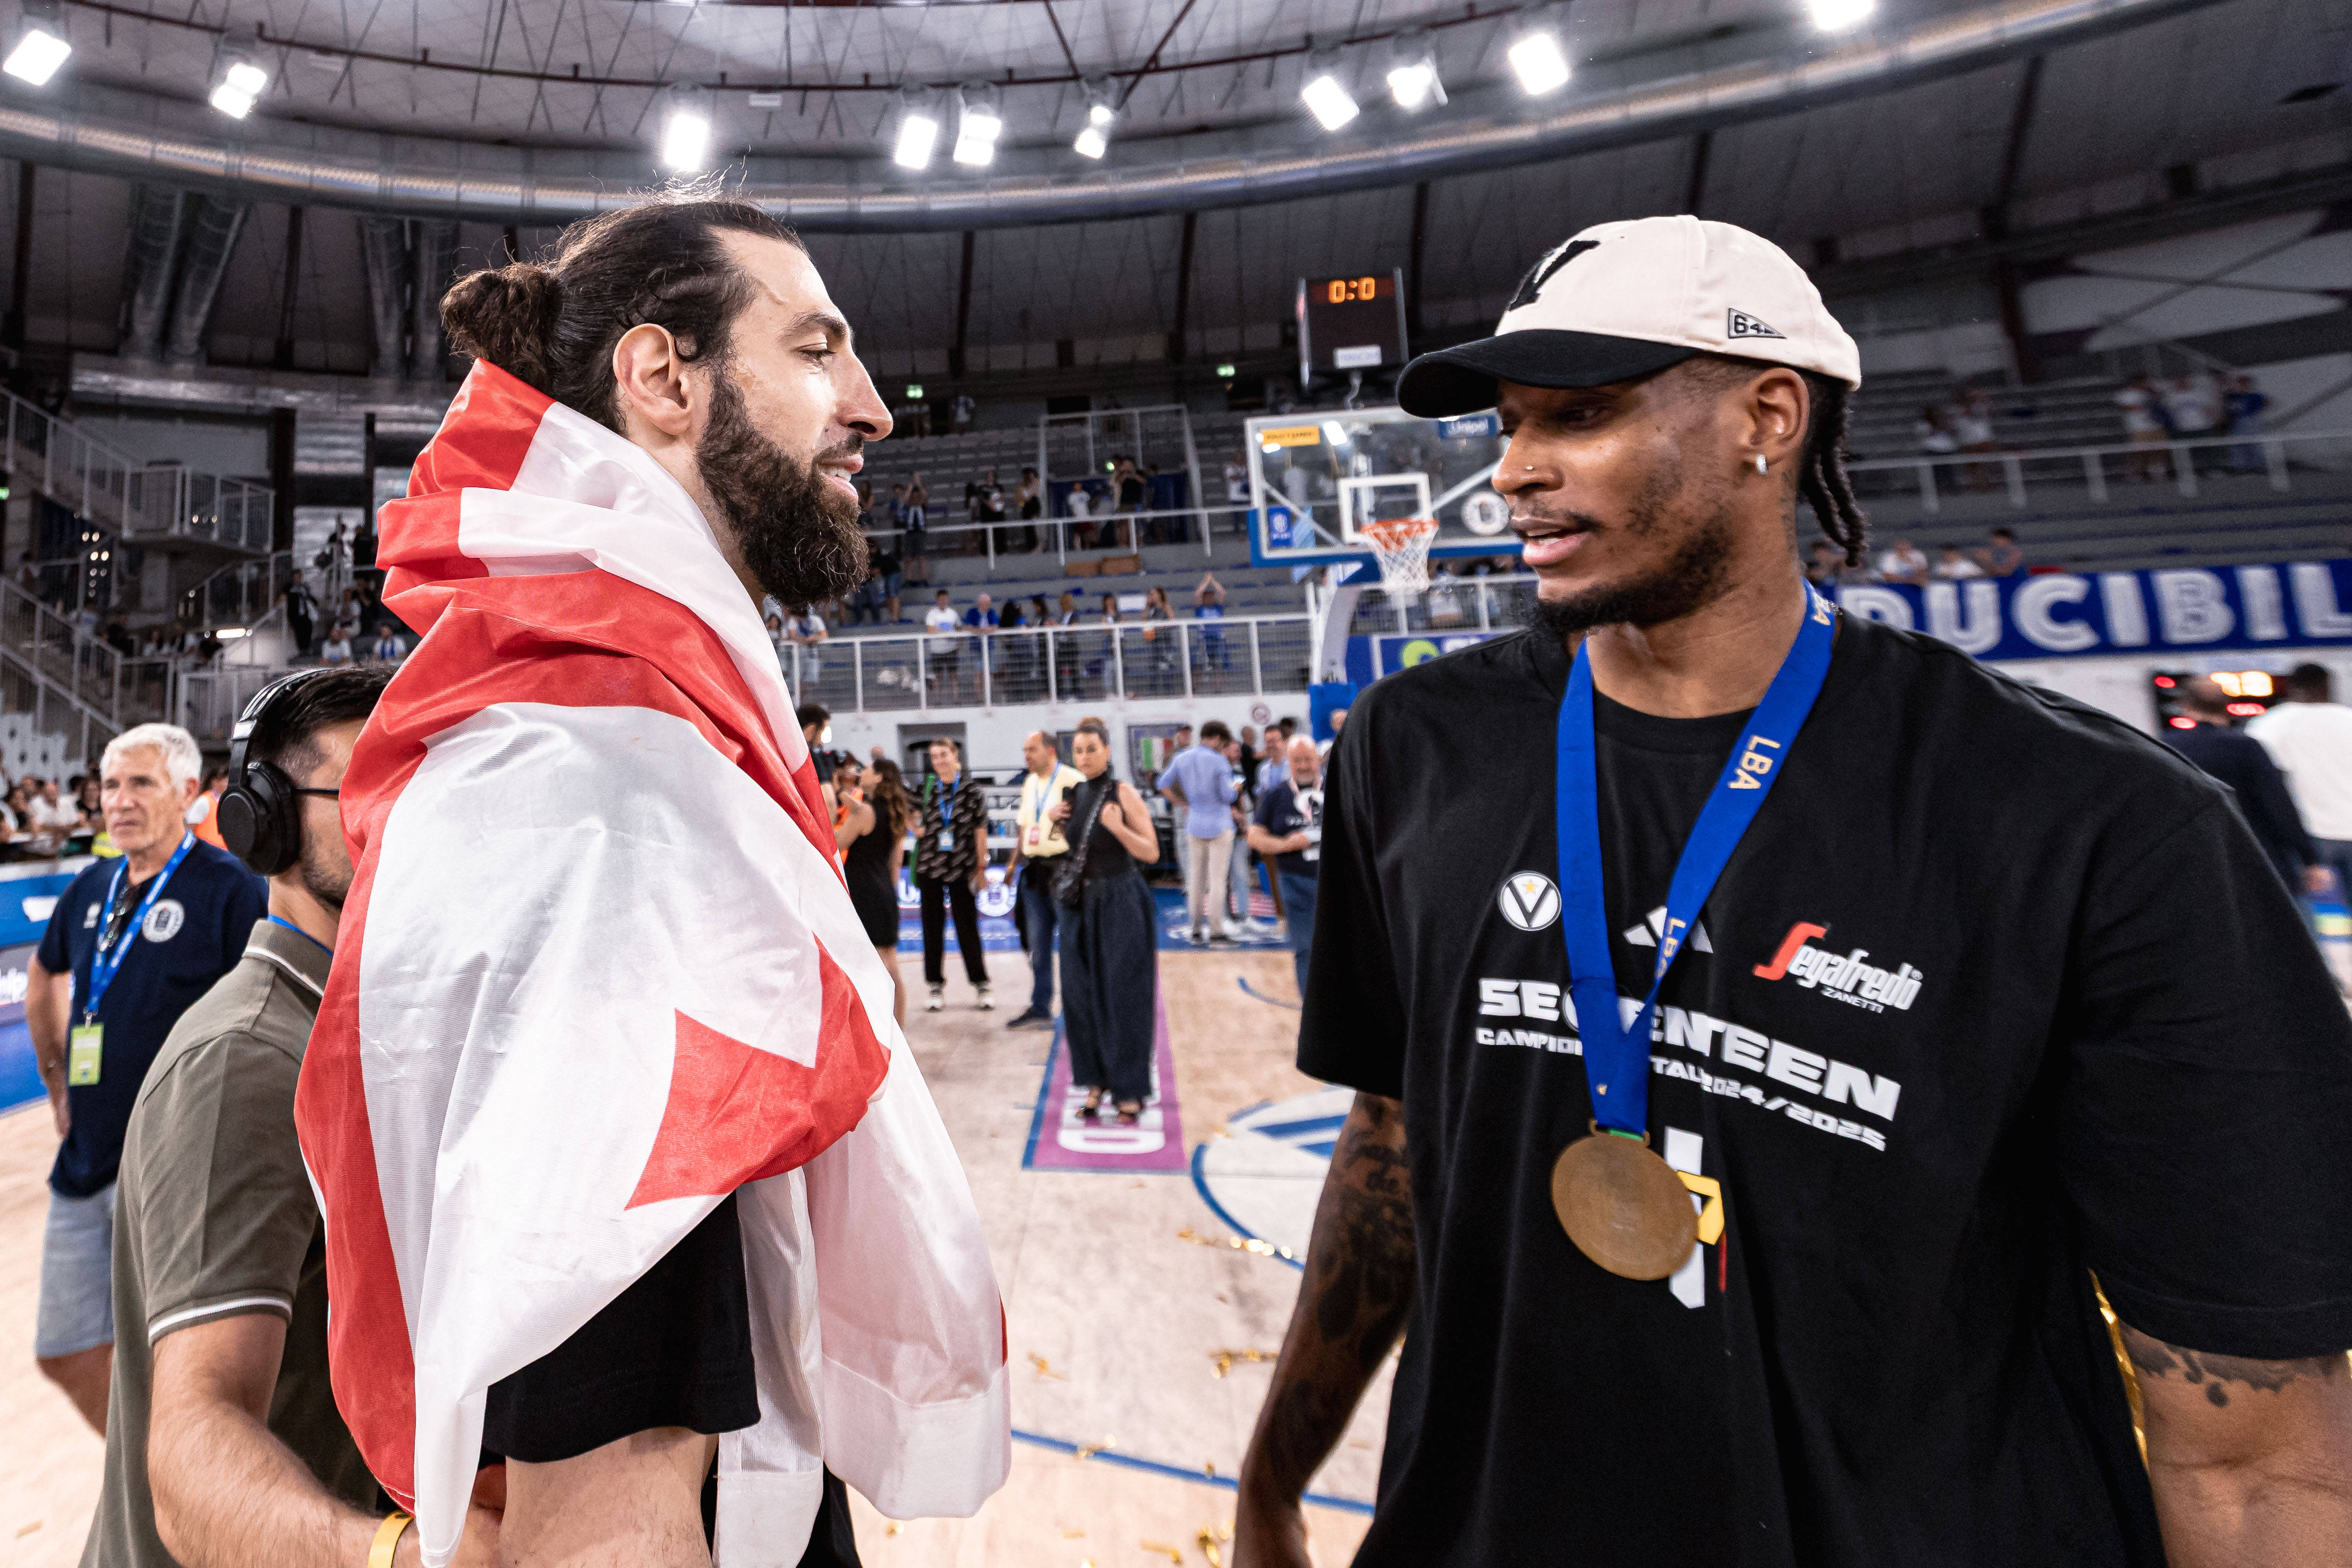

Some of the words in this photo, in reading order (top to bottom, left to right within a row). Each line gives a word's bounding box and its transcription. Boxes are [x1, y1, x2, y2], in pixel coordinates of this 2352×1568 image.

[1328, 276, 1376, 304] 0:0
[1728, 735, 1781, 790] LBA
[1752, 921, 1922, 1010] Segafredo
[1821, 986, 1885, 1013] ZANETTI
[1478, 978, 1901, 1121] SEENTEEN
